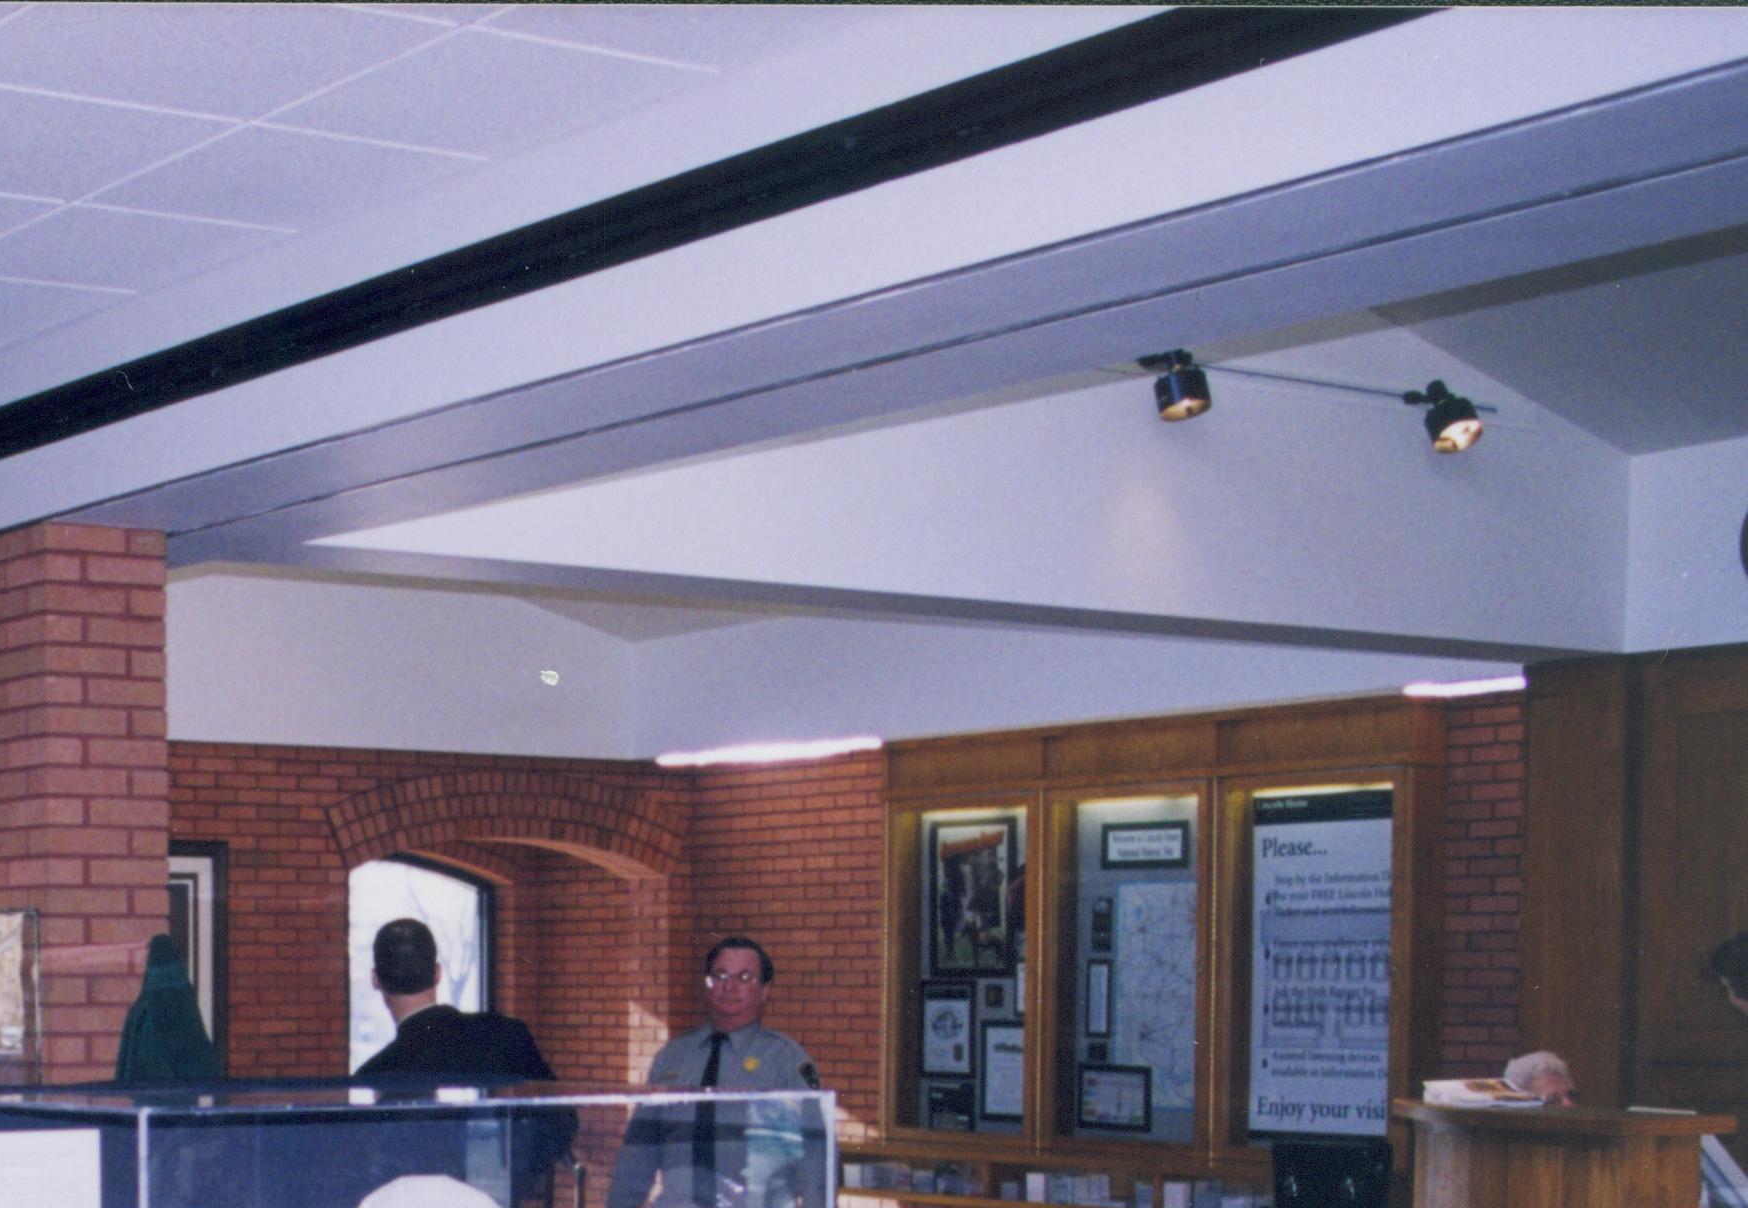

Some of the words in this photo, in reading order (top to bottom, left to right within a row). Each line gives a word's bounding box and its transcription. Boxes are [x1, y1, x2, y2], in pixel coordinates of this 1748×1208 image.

[1262, 837, 1329, 858] Please...
[1324, 871, 1380, 883] Information
[1311, 888, 1335, 900] FREE
[1258, 1096, 1305, 1121] Enjoy
[1310, 1102, 1351, 1123] your
[1355, 1098, 1386, 1119] visi
